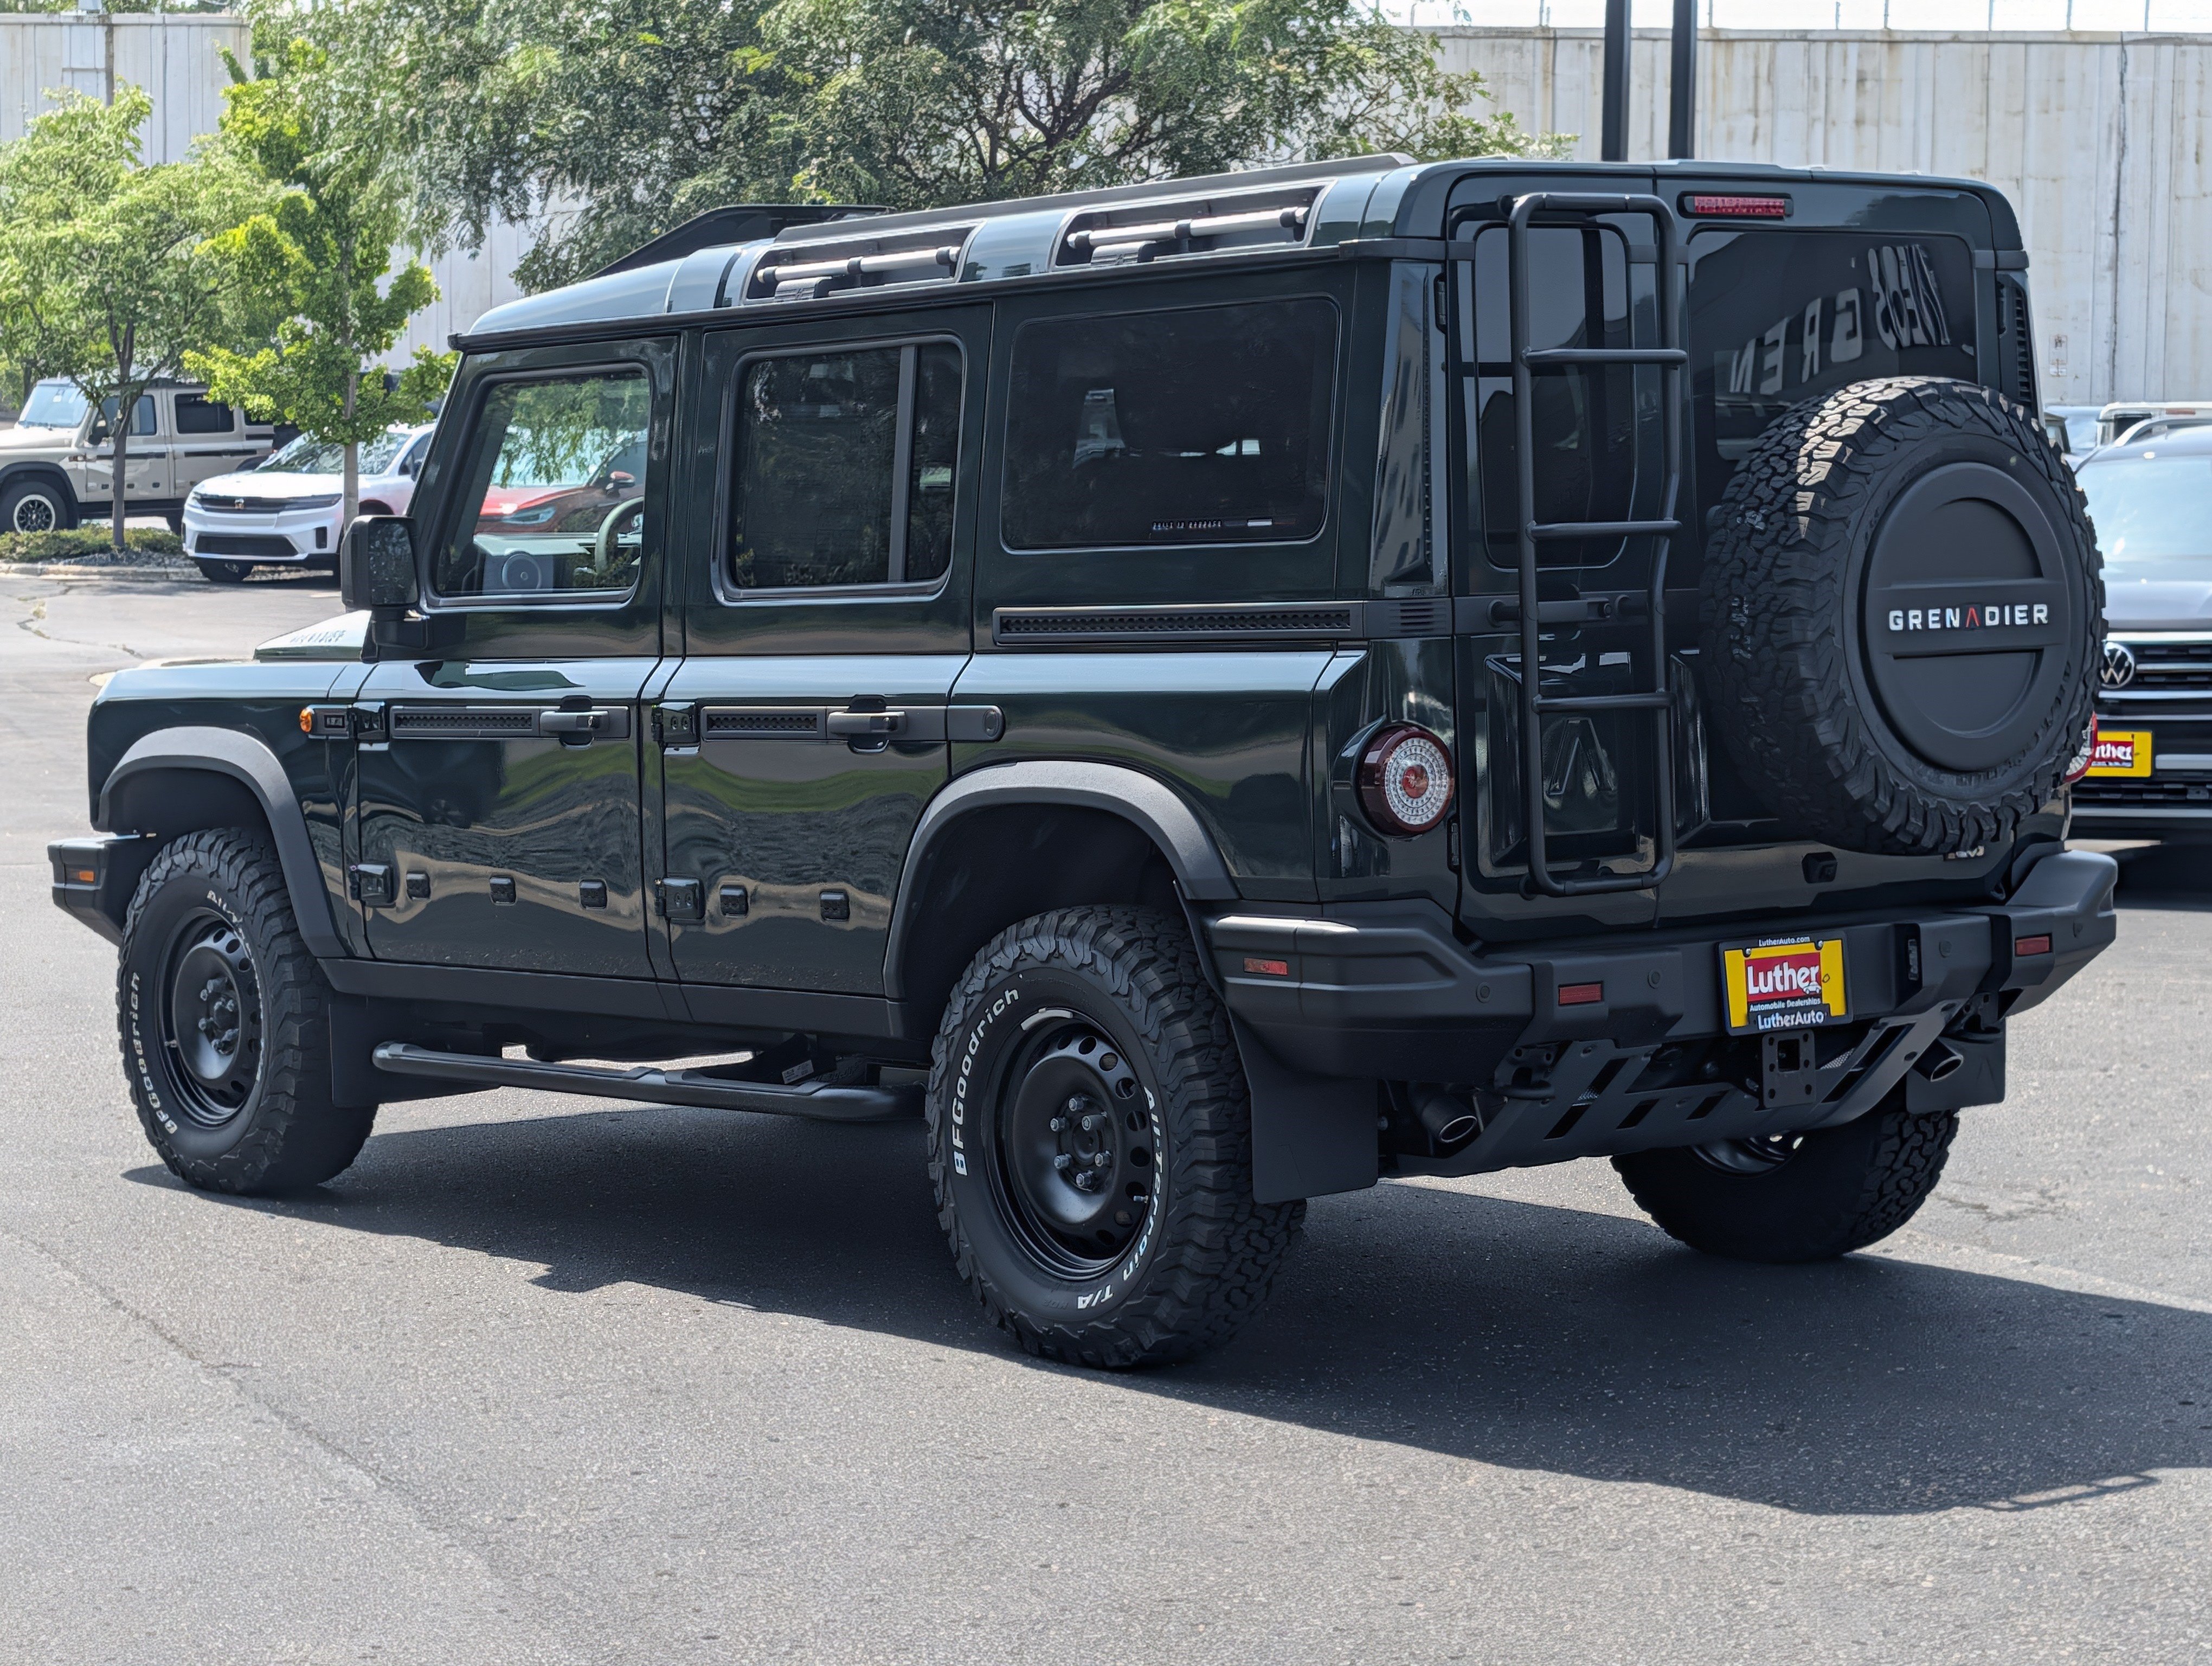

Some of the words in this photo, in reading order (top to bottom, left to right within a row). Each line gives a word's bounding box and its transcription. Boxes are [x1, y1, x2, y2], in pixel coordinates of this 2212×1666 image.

[1889, 604, 2048, 631] GRENADIER
[1759, 937, 1810, 947] LutherAuto.com
[1747, 962, 1819, 995] Luther
[1750, 1001, 1785, 1012] Automobile
[1787, 997, 1821, 1008] Dealerships
[1758, 1009, 1824, 1030] LutherAuto
[951, 988, 1019, 1177] BFGoodrich
[1122, 1086, 1165, 1281] All-Terrain
[1077, 1284, 1115, 1310] T/A
